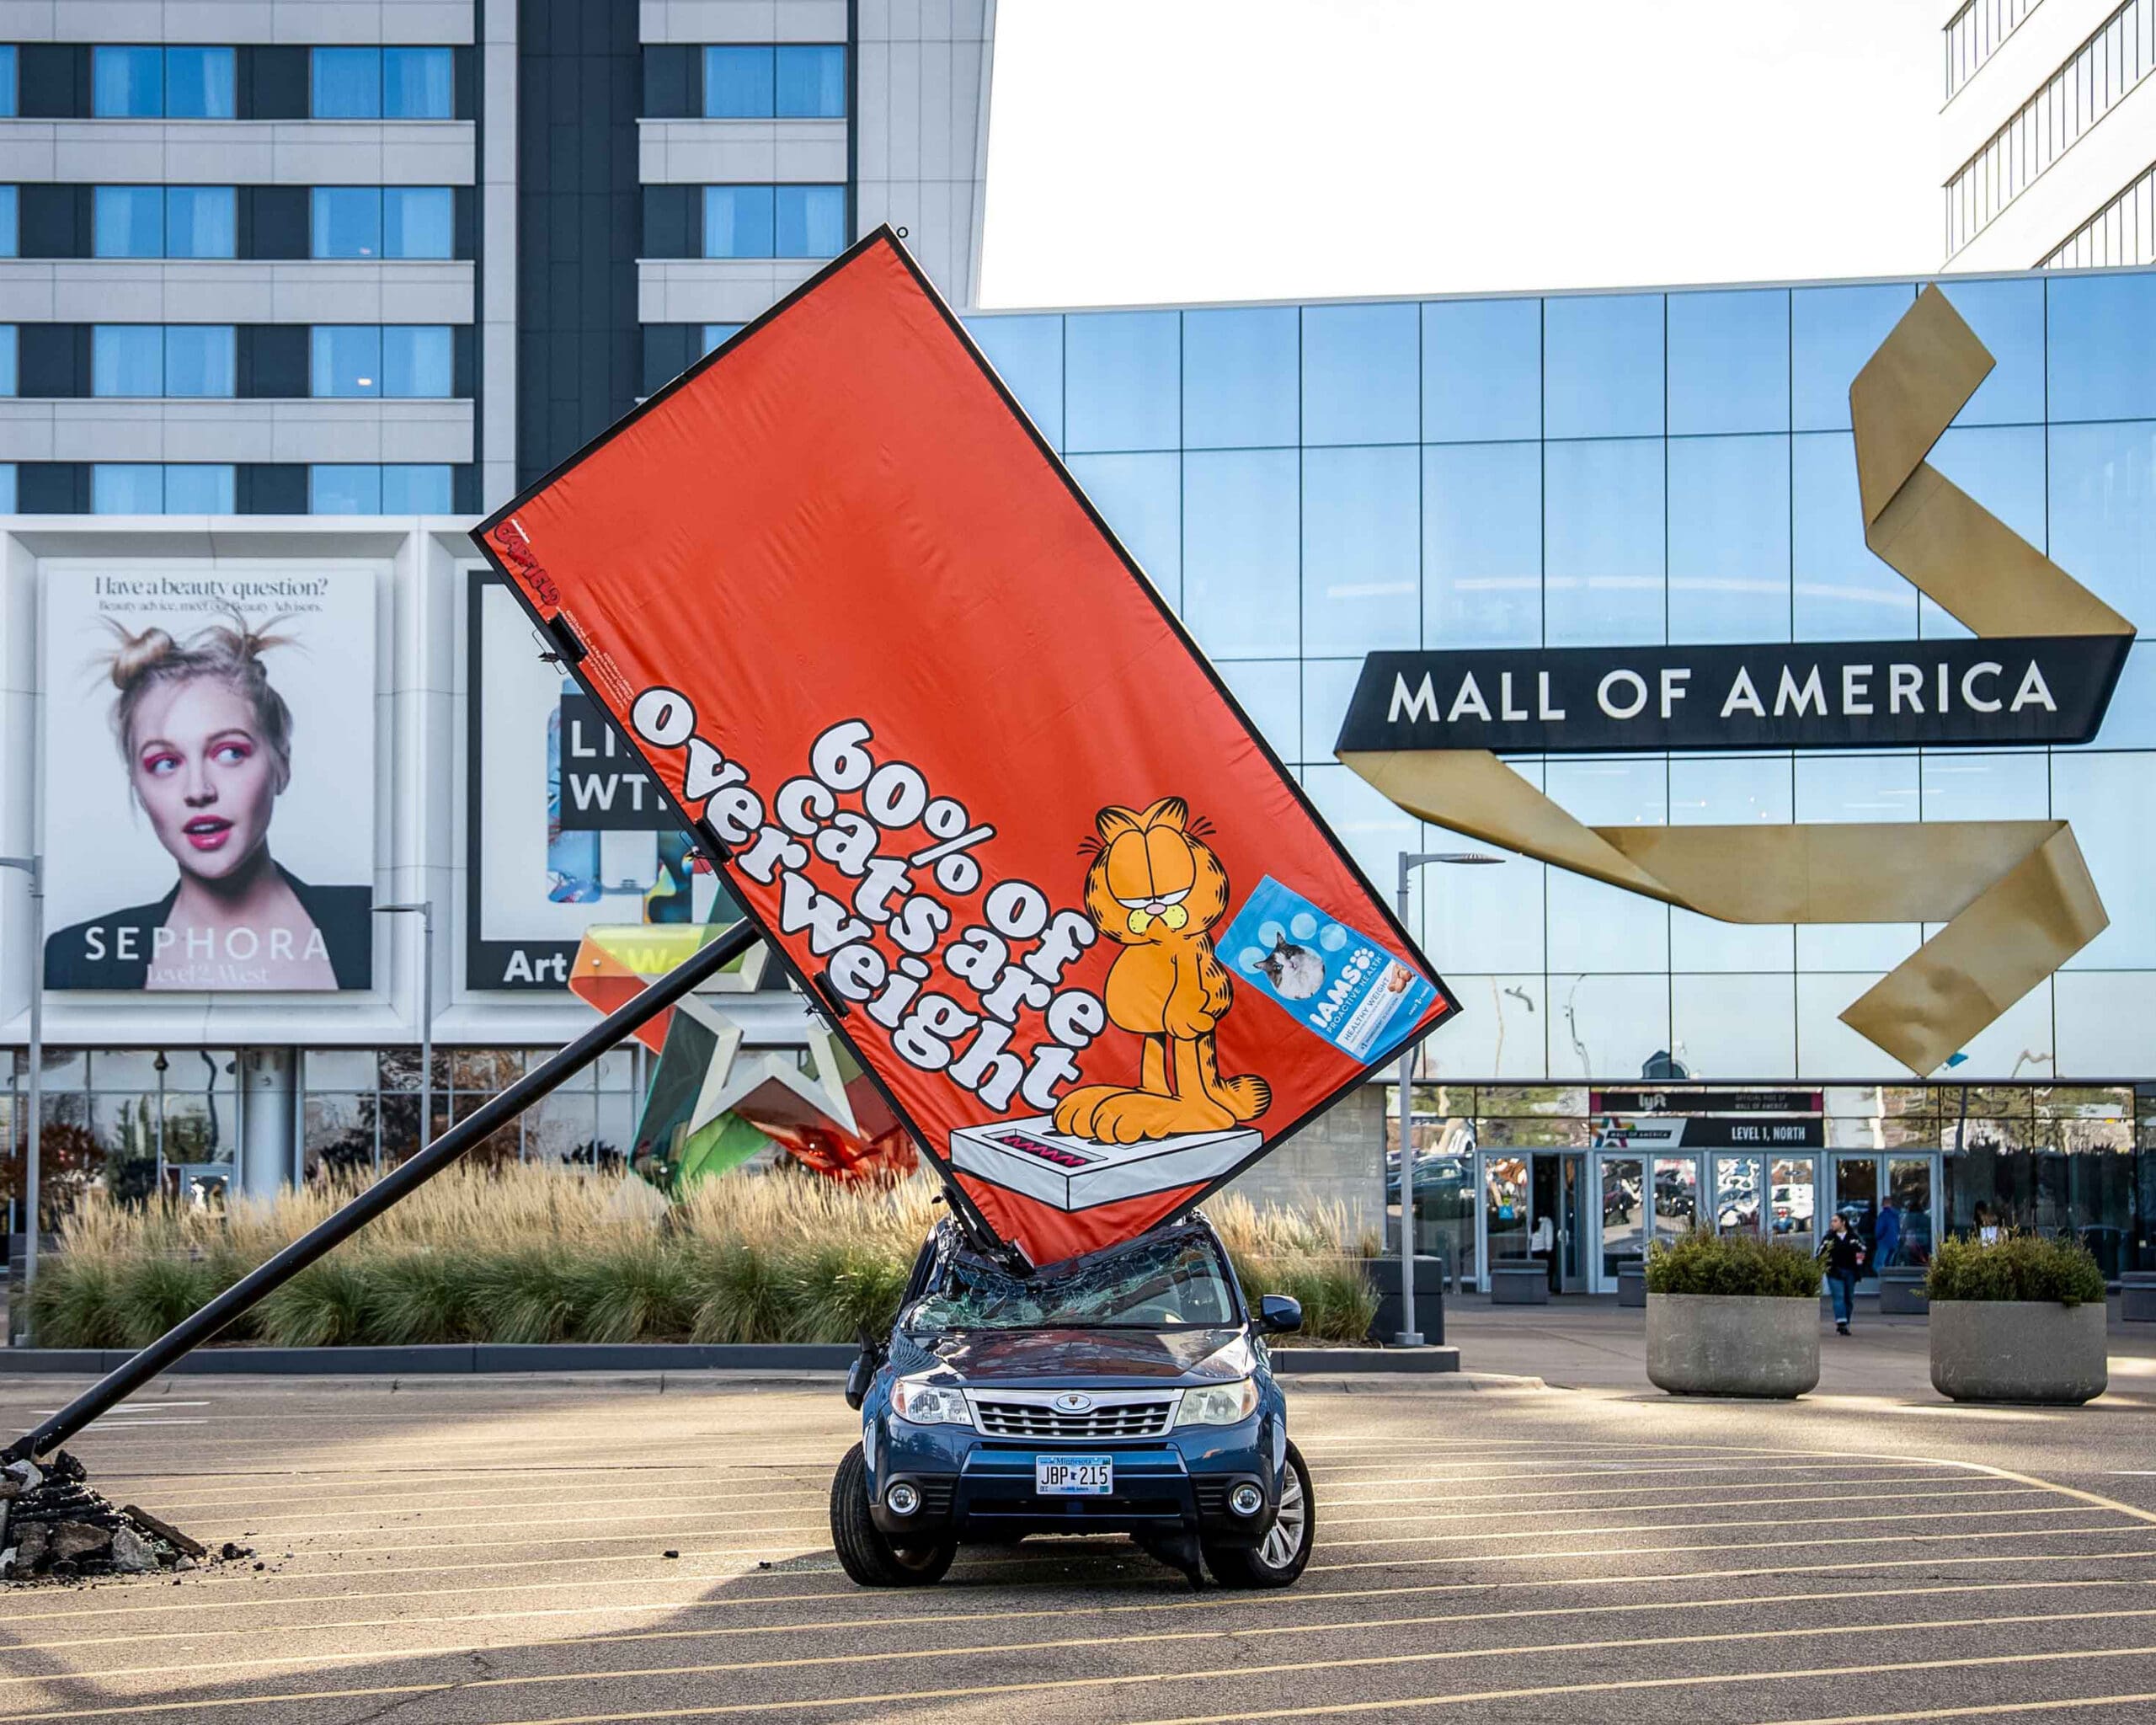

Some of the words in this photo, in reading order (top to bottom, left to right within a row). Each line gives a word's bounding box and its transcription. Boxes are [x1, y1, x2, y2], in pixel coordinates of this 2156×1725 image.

[494, 521, 561, 606] GARFIELD
[94, 576, 144, 595] Have
[146, 582, 158, 595] a
[162, 576, 228, 599] beauty
[232, 577, 329, 601] question?
[1386, 670, 1566, 724] MALL
[1596, 668, 1691, 720] OF
[1720, 659, 2058, 718] AMERICA
[572, 720, 632, 757] LI
[568, 773, 668, 810] WT
[809, 718, 997, 896] 60%
[983, 879, 1097, 985] of
[775, 777, 951, 954] cats
[942, 924, 1107, 1049] are
[85, 926, 330, 960] SEPHORA
[147, 964, 195, 983] Level
[216, 964, 270, 984] West
[504, 950, 568, 982] Art
[1309, 964, 1363, 1029] IAMS
[1325, 986, 1362, 1033] PROACTIVE
[1357, 955, 1383, 986] HEALTH
[1342, 1006, 1370, 1040] HEALTHY
[1366, 977, 1390, 1007] WEIGHT
[1732, 1127, 1761, 1140] LEVEL
[1763, 1127, 1770, 1142] 1,
[1773, 1126, 1806, 1140] NORTH
[1041, 1466, 1069, 1485] JBP
[1080, 1466, 1108, 1485] 215
